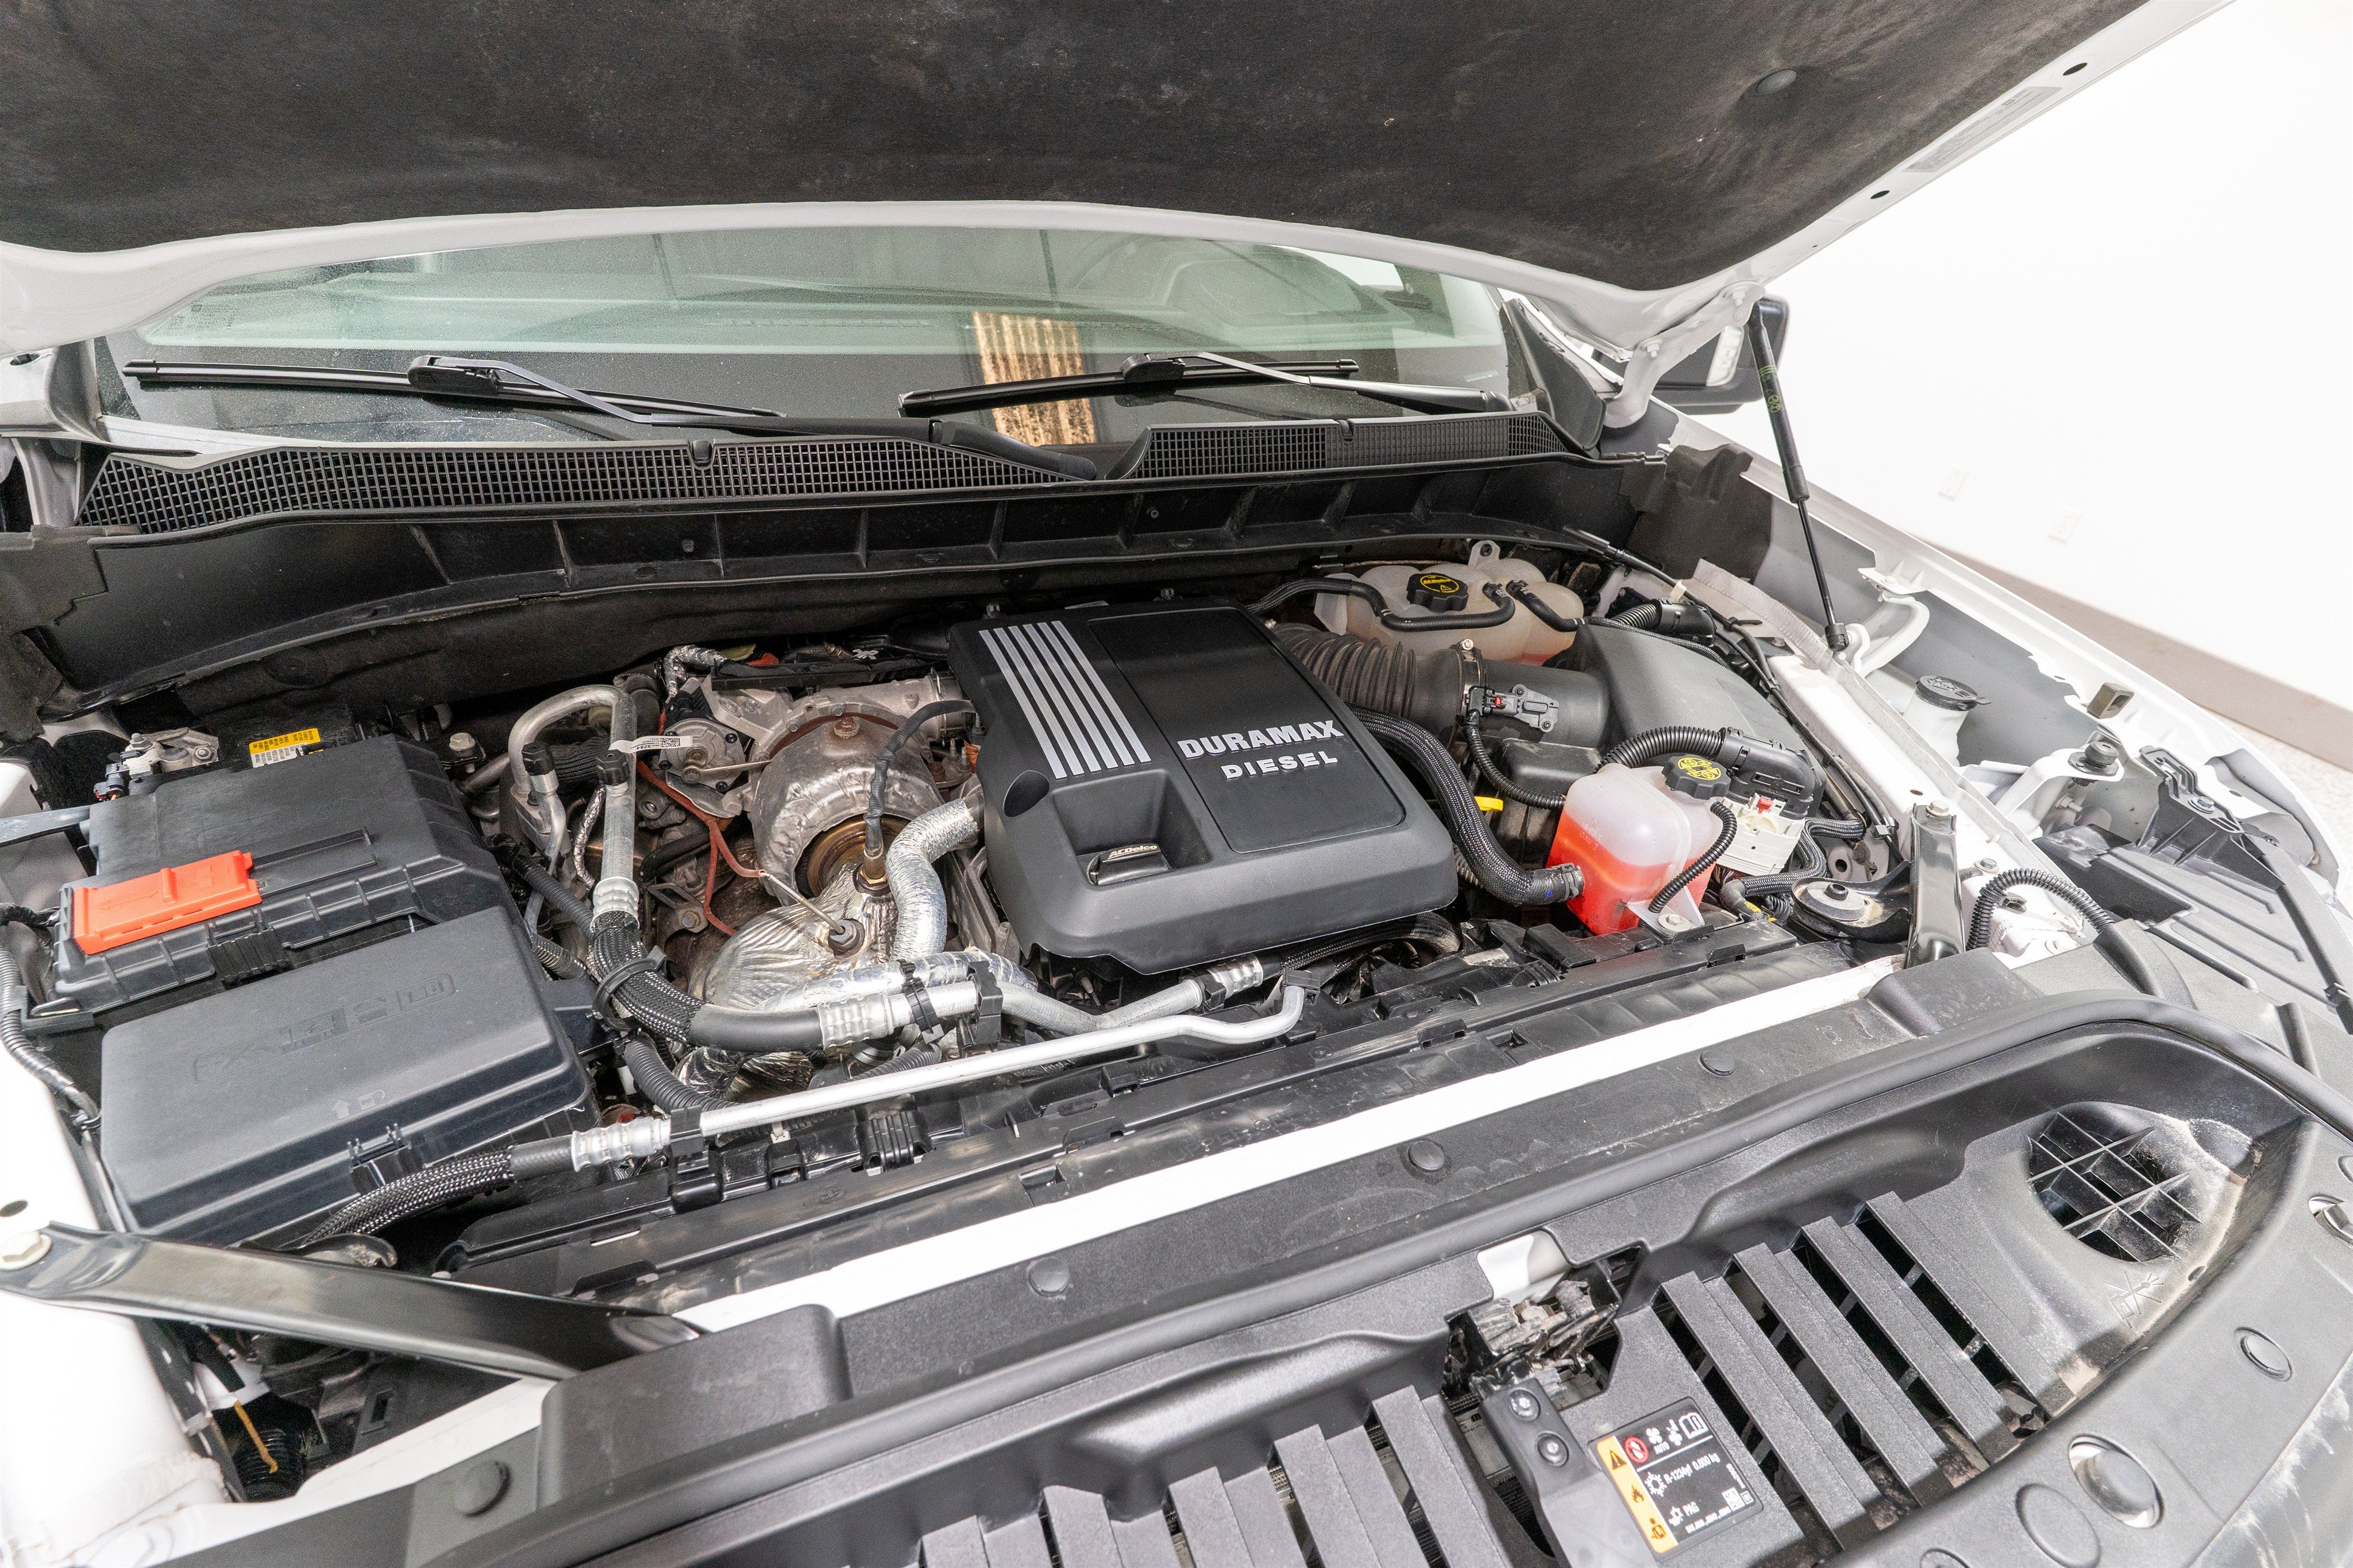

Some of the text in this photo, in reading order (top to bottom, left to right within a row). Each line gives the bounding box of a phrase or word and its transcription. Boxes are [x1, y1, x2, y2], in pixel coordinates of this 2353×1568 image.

[1177, 720, 1344, 759] DURAMAX
[1221, 751, 1338, 780] DIESEL
[1108, 845, 1158, 858] ACDelco
[1653, 1441, 1669, 1455] AUTO
[1663, 1463, 1693, 1484] R-1234yf
[1710, 1453, 1721, 1463] kg
[1683, 1501, 1700, 1517] PAG
